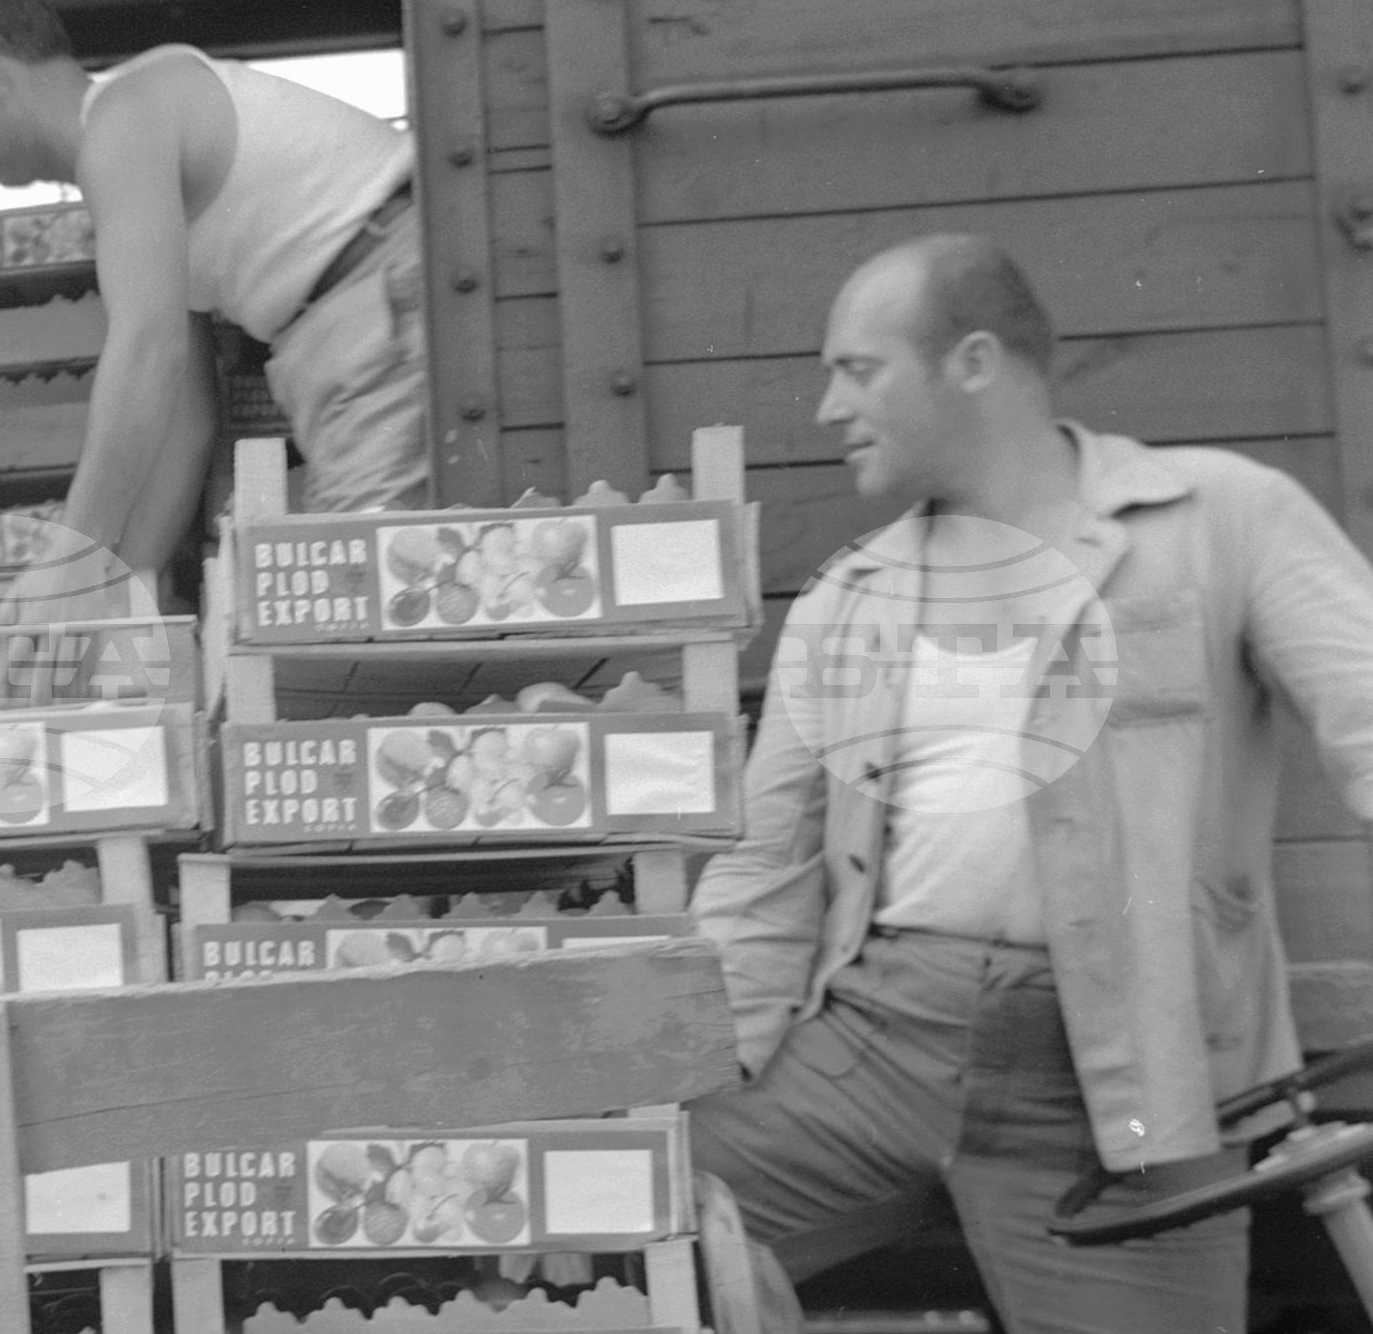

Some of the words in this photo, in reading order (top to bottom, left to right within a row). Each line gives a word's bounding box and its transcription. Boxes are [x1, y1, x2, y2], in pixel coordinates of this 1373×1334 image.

[257, 569, 329, 596] PLOD
[258, 596, 369, 626] EXPORT
[245, 769, 317, 795] PLOD
[246, 798, 357, 825] EXPORT
[185, 1181, 257, 1207] PLOD
[185, 1210, 296, 1237] EXPORT
